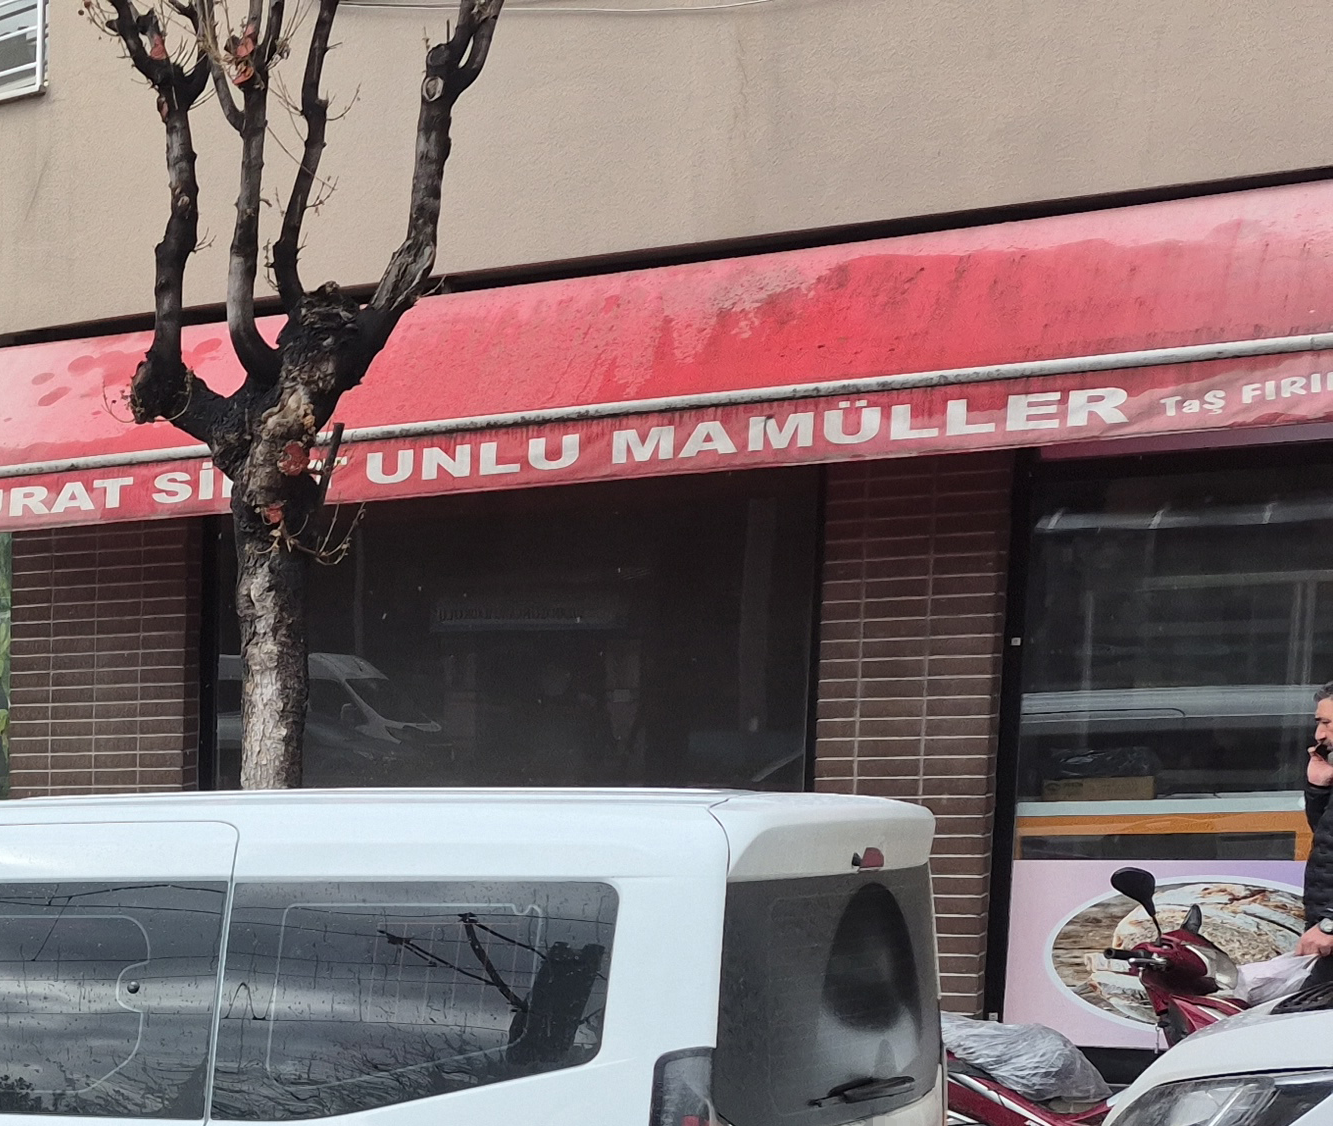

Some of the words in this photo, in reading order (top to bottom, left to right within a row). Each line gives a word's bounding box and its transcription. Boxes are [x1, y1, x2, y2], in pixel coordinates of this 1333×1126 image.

[152, 455, 348, 503] SİT
[365, 433, 580, 485] UNLU
[611, 386, 1130, 464] MAMÜLLER
